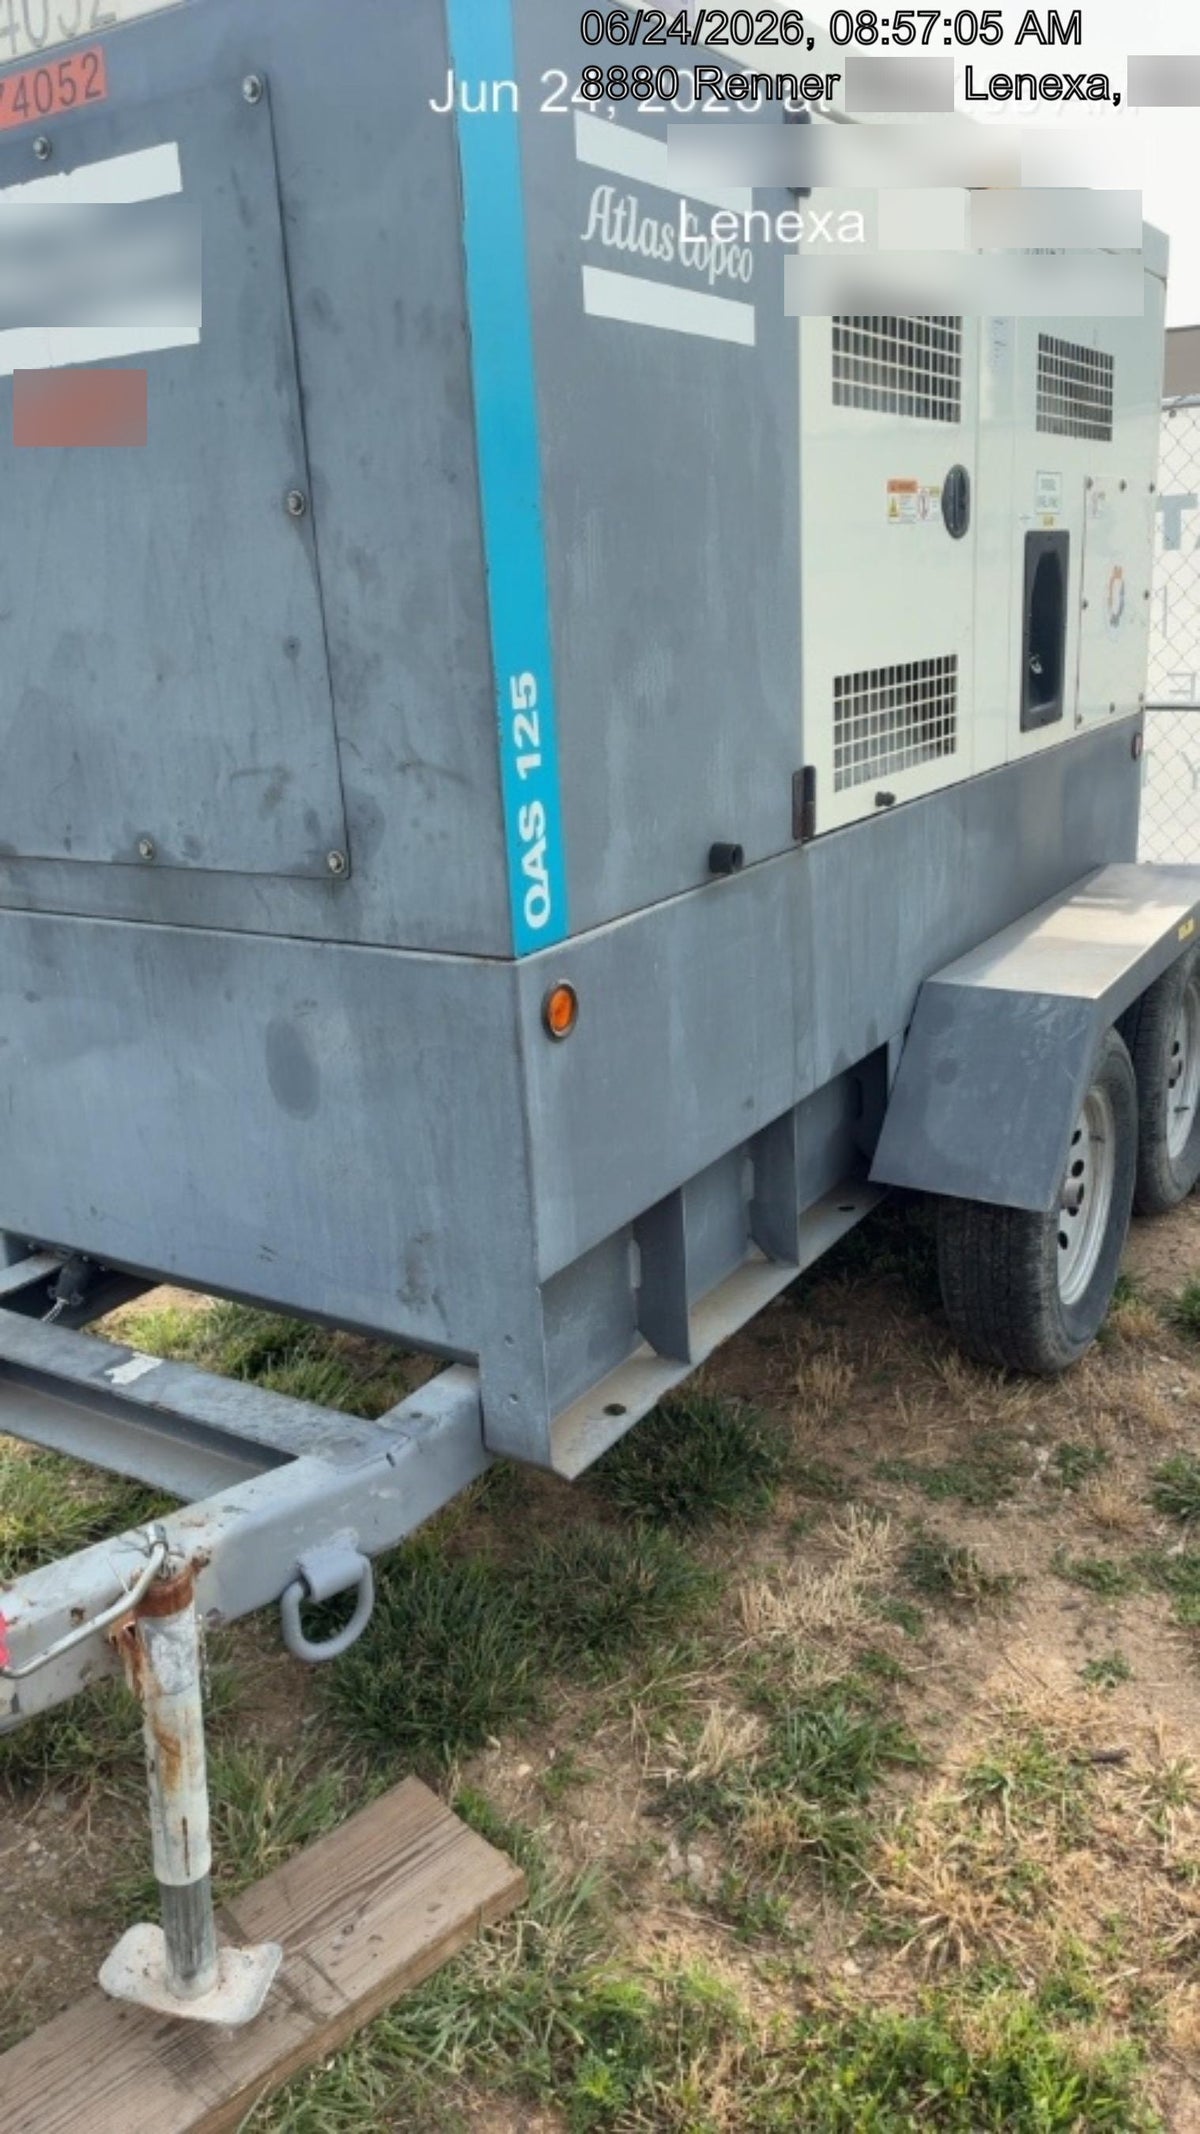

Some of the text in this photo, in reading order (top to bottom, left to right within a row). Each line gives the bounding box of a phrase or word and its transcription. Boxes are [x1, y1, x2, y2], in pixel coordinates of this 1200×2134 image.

[0, 52, 102, 118] 4052
[581, 184, 676, 262] Atlas
[510, 672, 550, 929] QAS 125
